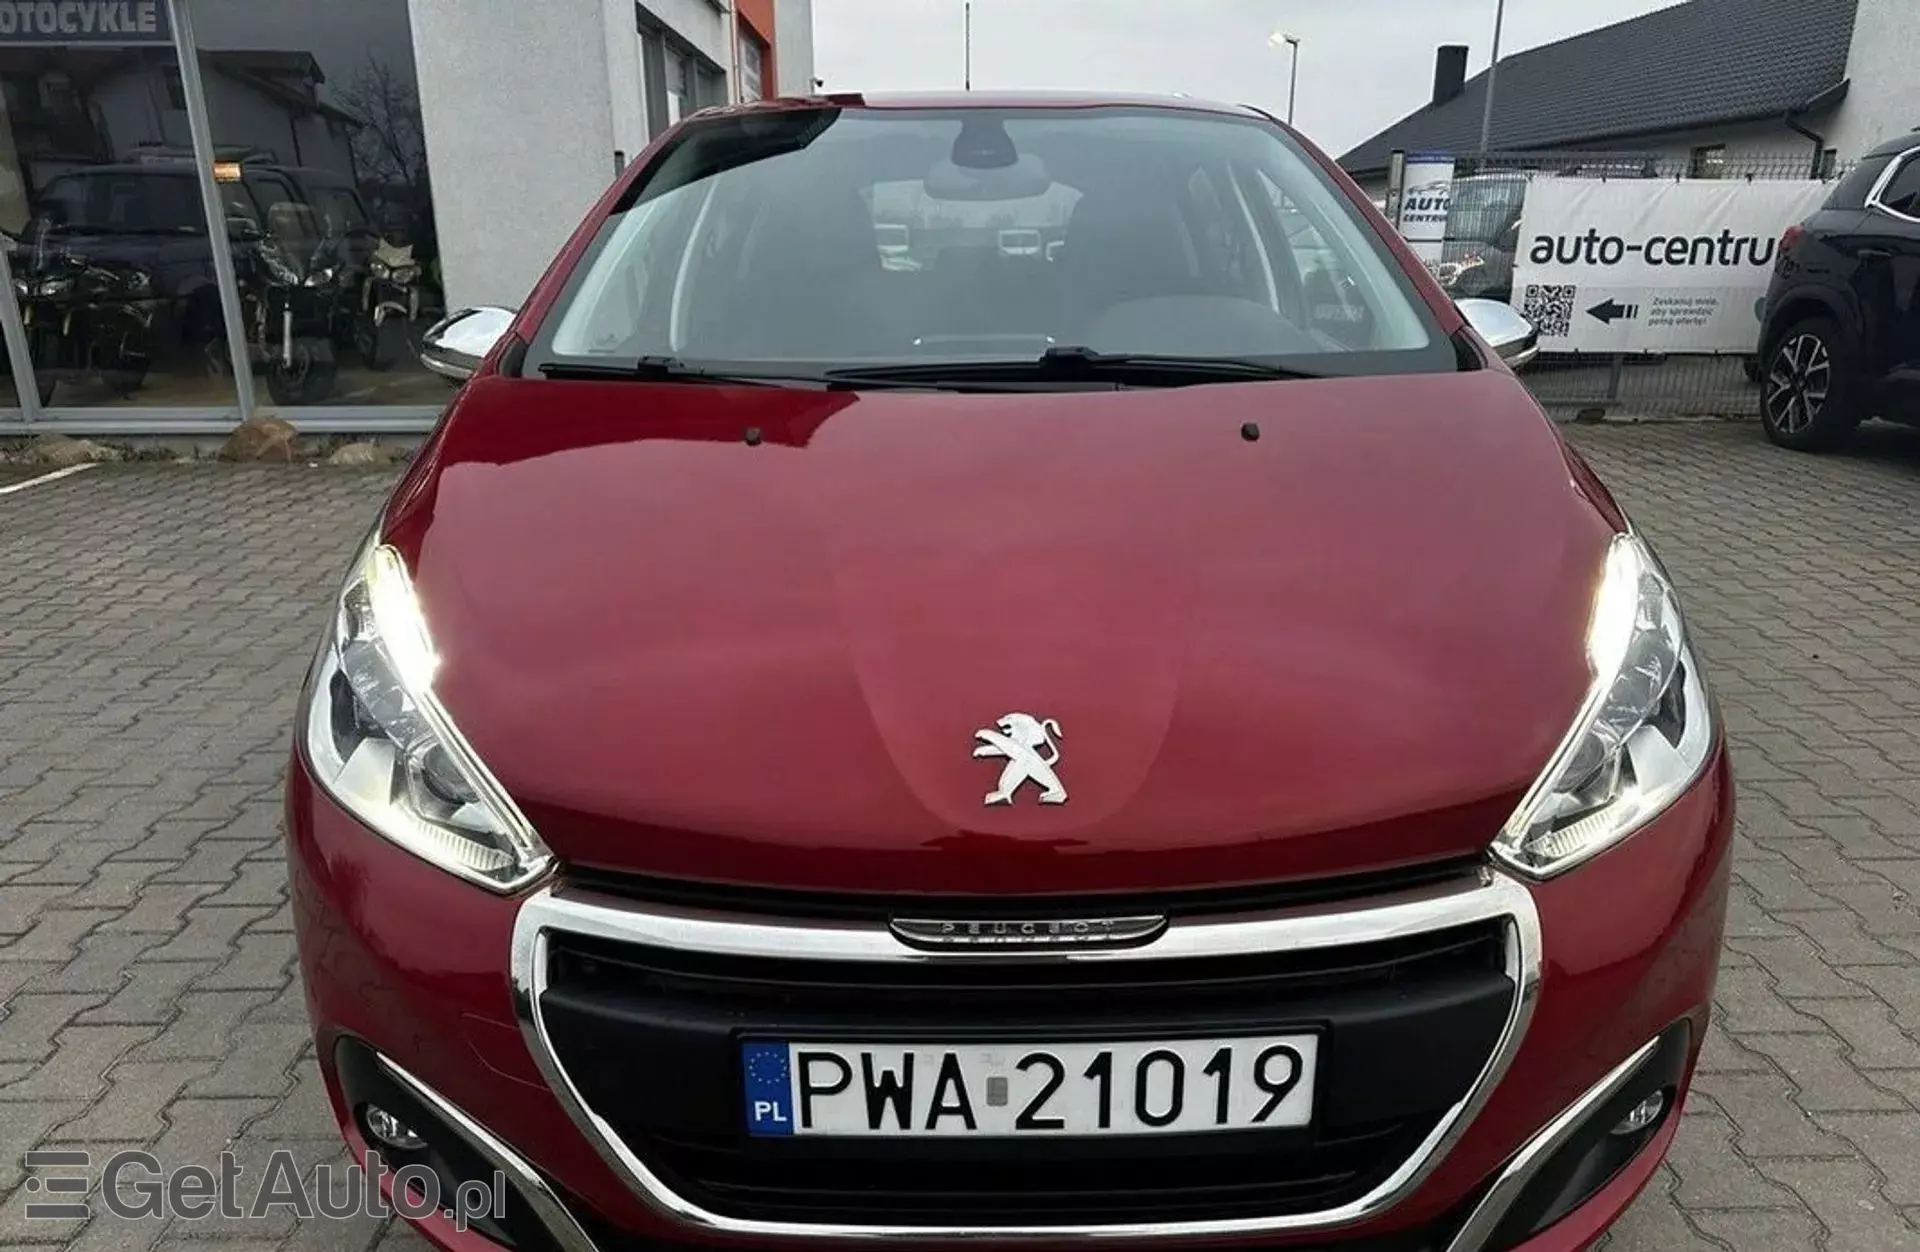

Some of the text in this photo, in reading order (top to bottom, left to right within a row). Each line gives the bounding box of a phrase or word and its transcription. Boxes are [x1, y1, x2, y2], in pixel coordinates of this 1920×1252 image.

[1404, 198, 1451, 210] AUTO
[941, 920, 1114, 935] PEUGEOT
[798, 1044, 1304, 1131] PWA 21019
[754, 1101, 787, 1122] PL
